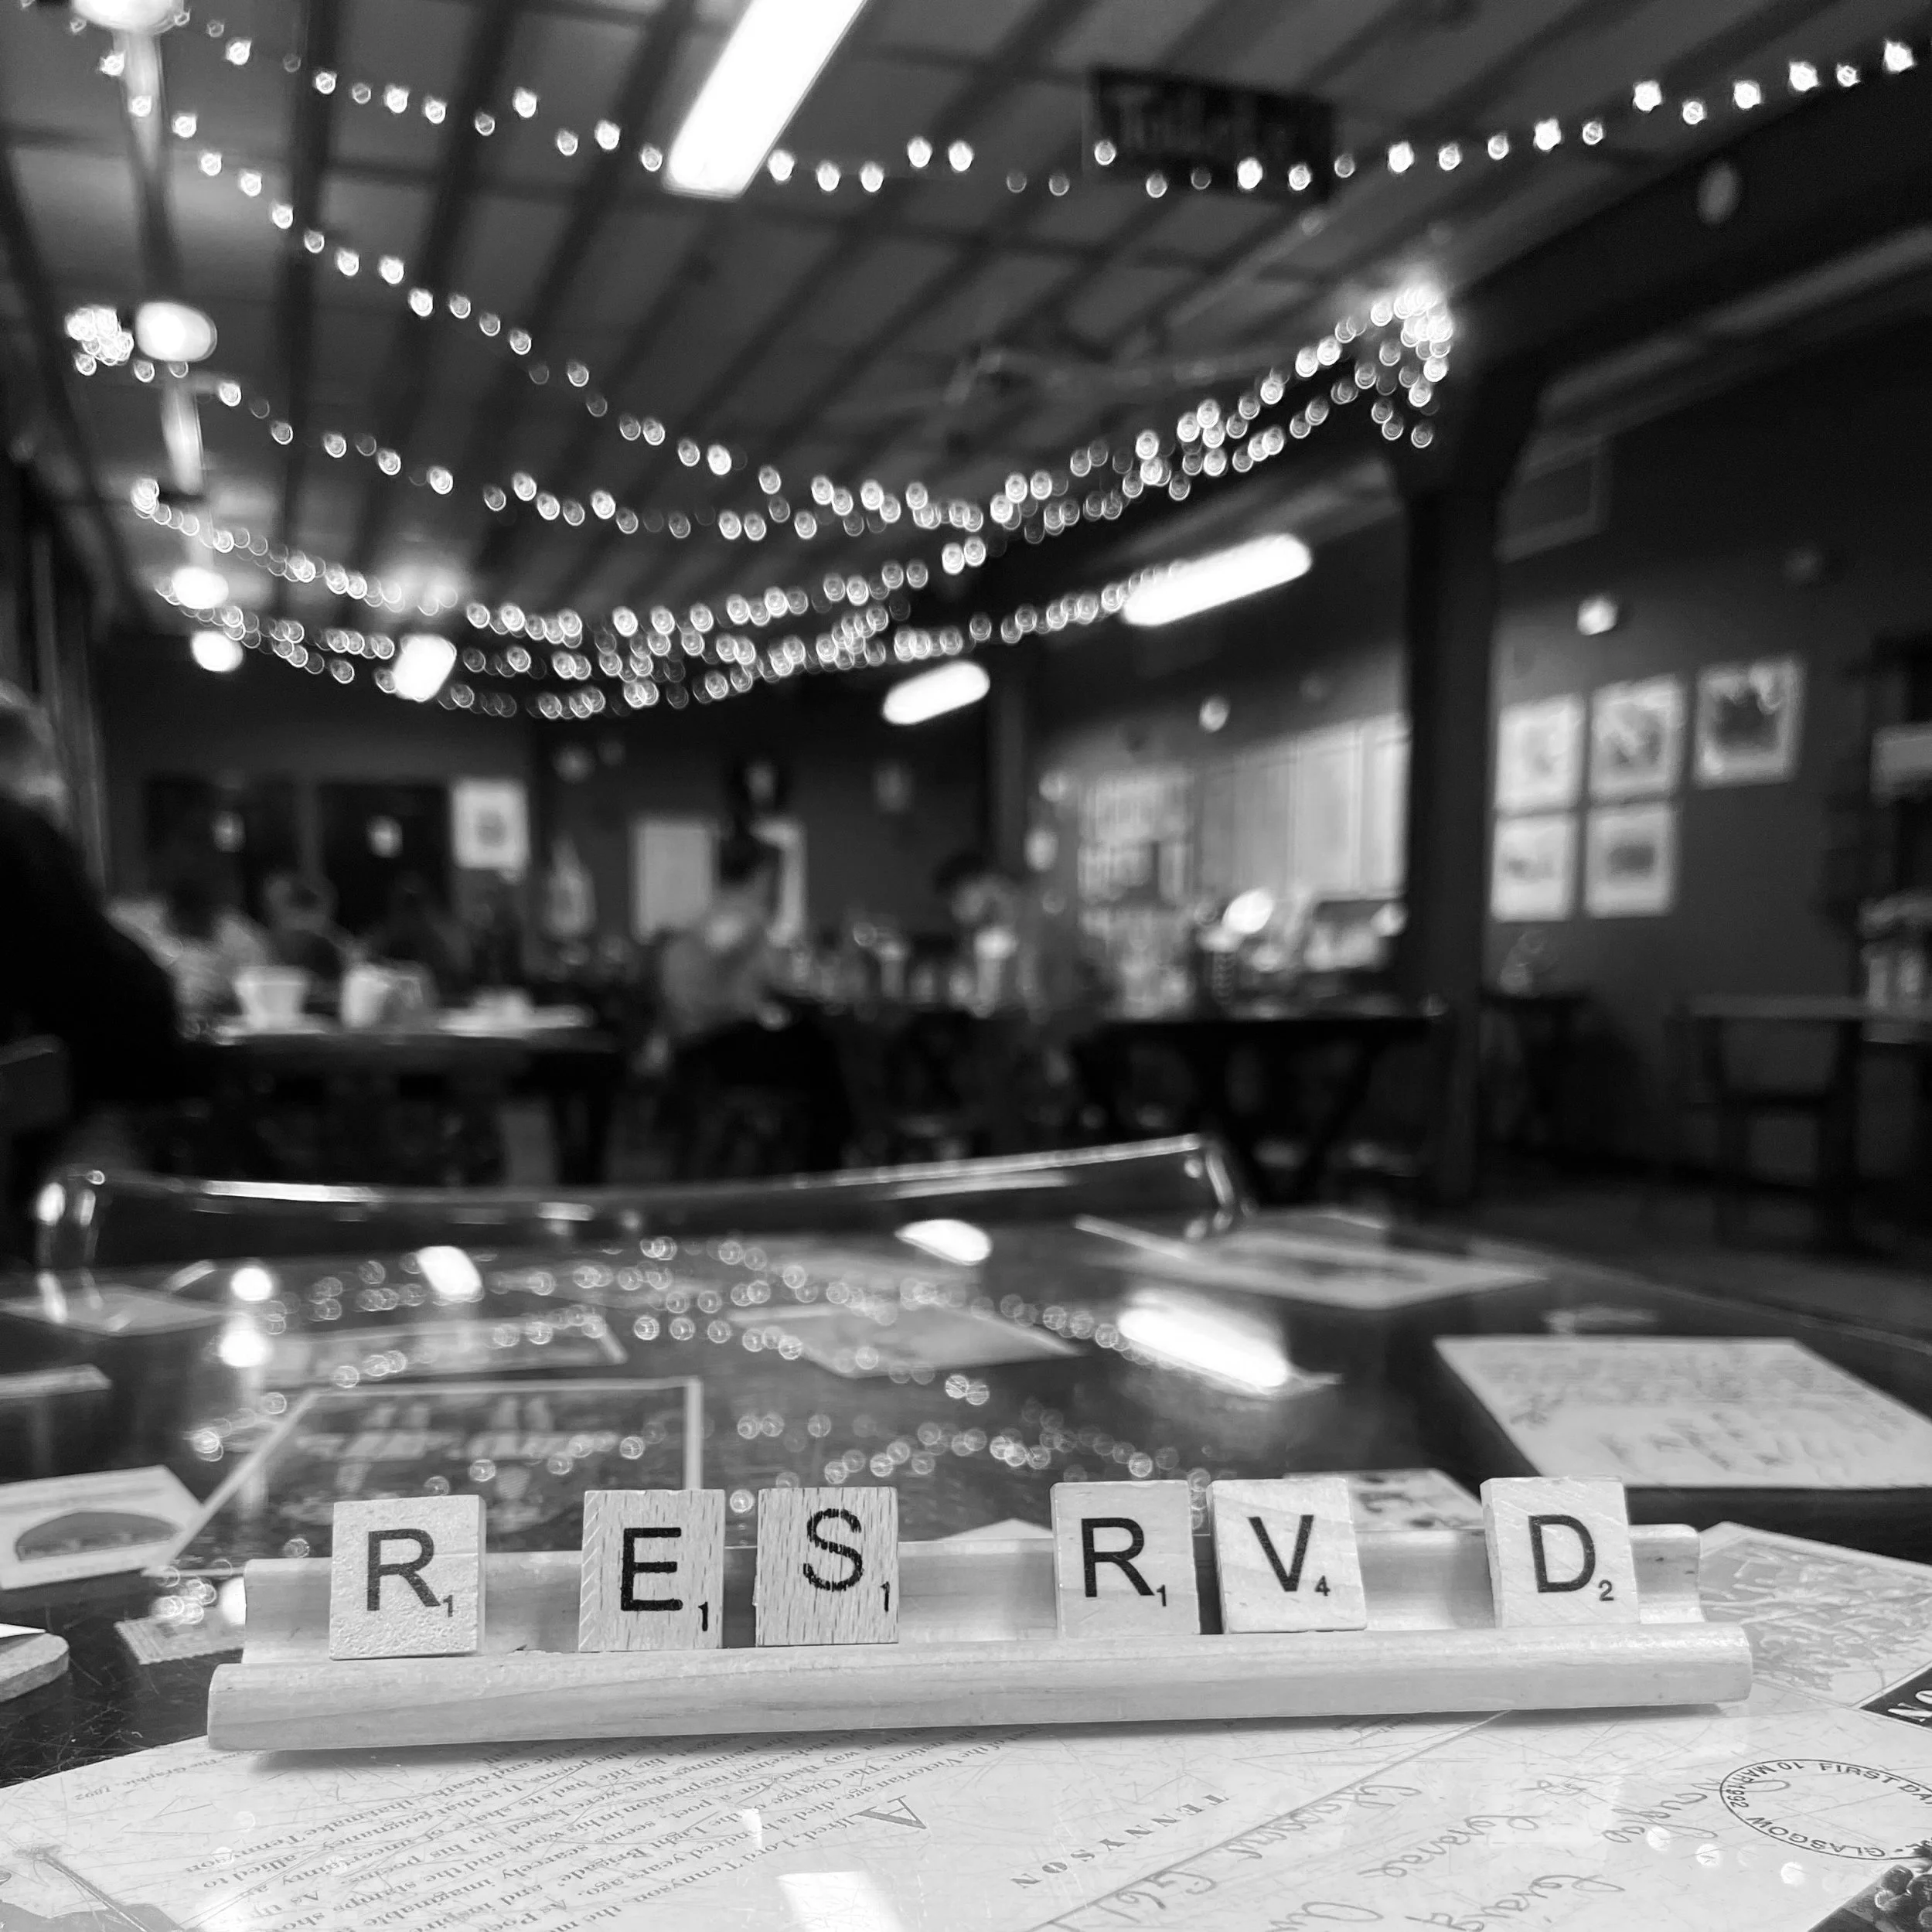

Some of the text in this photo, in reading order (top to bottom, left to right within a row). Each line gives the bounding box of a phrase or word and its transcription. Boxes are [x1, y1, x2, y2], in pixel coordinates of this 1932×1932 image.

[366, 1508, 1596, 1612] R E S R V D
[1156, 1583, 1167, 1607] 1
[1314, 1575, 1331, 1596] 4
[1598, 1579, 1615, 1602] 2
[441, 1594, 454, 1618] 1
[879, 1581, 890, 1613] 1
[697, 1601, 710, 1633] 1
[750, 1753, 791, 1772] vein
[823, 1751, 860, 1765] way
[959, 1746, 989, 1758] the
[491, 1762, 530, 1780] and
[597, 1768, 634, 1784] life
[634, 1758, 668, 1774] his
[730, 1766, 751, 1780] of
[875, 1758, 963, 1787] Victorian
[1818, 1763, 1900, 1783] FIRST
[428, 1775, 489, 1797] death
[501, 1784, 523, 1793] It
[550, 1780, 595, 1798] had
[625, 1775, 669, 1791] that
[741, 1781, 771, 1795] for
[771, 1778, 842, 1804] Charge
[834, 1784, 875, 1801] age,
[1726, 1761, 1804, 1808] 10 MAR 1992
[482, 1791, 503, 1799] is
[519, 1795, 548, 1807] its
[572, 1790, 622, 1809] were
[622, 1775, 731, 1813] inspiration
[366, 1796, 414, 1817] that
[436, 1797, 481, 1814] that
[598, 1811, 625, 1821] in
[659, 1799, 714, 1818] poet,
[791, 1801, 836, 1821] died
[304, 1813, 368, 1835] make
[452, 1804, 512, 1831] share
[505, 1808, 571, 1835] based
[566, 1818, 602, 1833] his
[708, 1812, 743, 1826] the
[793, 1795, 927, 1842] Alfred,
[321, 1811, 434, 1852] poignancy
[420, 1829, 445, 1842] of
[469, 1831, 497, 1844] on
[508, 1831, 565, 1853] work
[595, 1821, 656, 1845] seems
[649, 1821, 707, 1849] Light
[687, 1822, 780, 1859] hndred
[1010, 1794, 1230, 1889] TENNYSON
[1744, 1816, 1886, 1858] GLASGOW
[429, 1844, 467, 1858] his
[502, 1842, 588, 1879] scarcely
[741, 1838, 799, 1863] Lord
[232, 1855, 298, 1882] allied
[282, 1838, 415, 1886] uncertainty
[341, 1855, 422, 1884] poems.
[463, 1851, 506, 1872] and
[627, 1853, 687, 1880] years
[203, 1877, 229, 1888] to
[426, 1867, 462, 1882] the
[290, 1891, 319, 1904] As
[333, 1881, 417, 1911] stamps
[499, 1884, 543, 1906] and
[578, 1879, 625, 1896] ago.
[363, 1879, 496, 1926] imaginable
[540, 1899, 567, 1913] As
